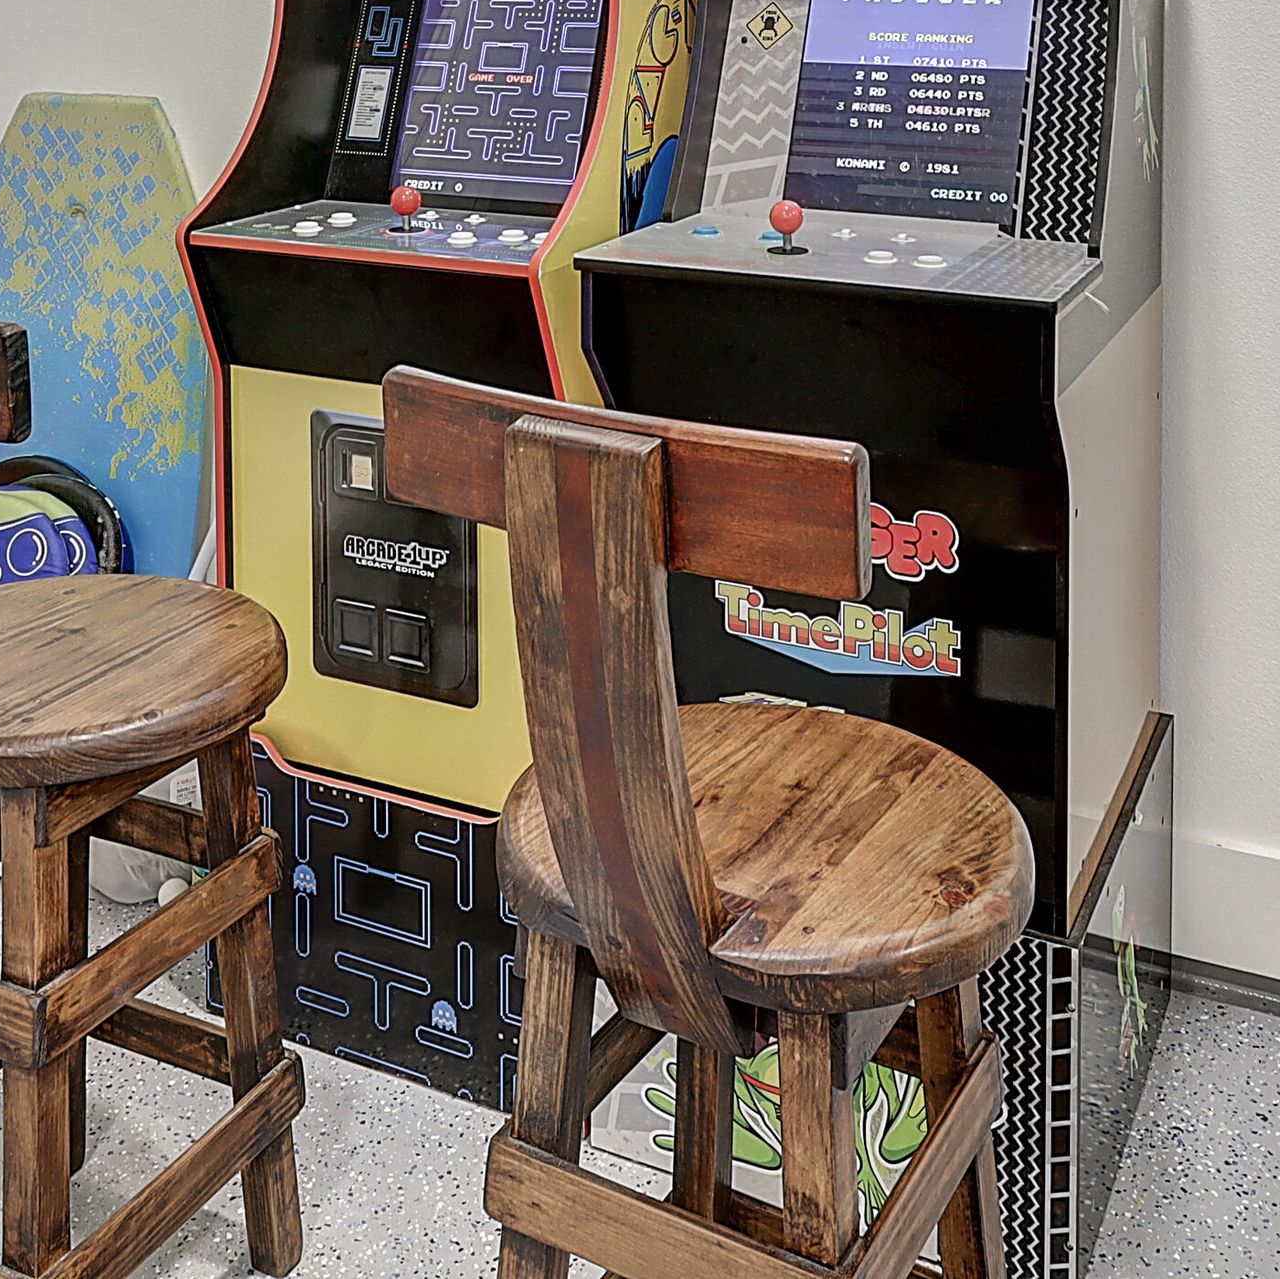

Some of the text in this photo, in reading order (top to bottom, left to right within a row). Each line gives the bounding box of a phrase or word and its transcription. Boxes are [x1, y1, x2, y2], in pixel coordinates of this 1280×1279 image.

[868, 32, 974, 44] SCORE RANKING
[961, 58, 988, 69] PTS
[468, 72, 534, 85] GAME OVER
[855, 70, 865, 81] 2
[871, 71, 889, 82] ND
[959, 74, 986, 85] PTS
[853, 86, 985, 101] 3 RD 06440 PTS
[849, 117, 981, 134] 5 TH 04610 PTS
[836, 157, 886, 171] KONAMI
[926, 163, 960, 175] 1981
[930, 188, 1009, 204] CREDIT 00
[355, 558, 435, 578] LEGACY EDITION
